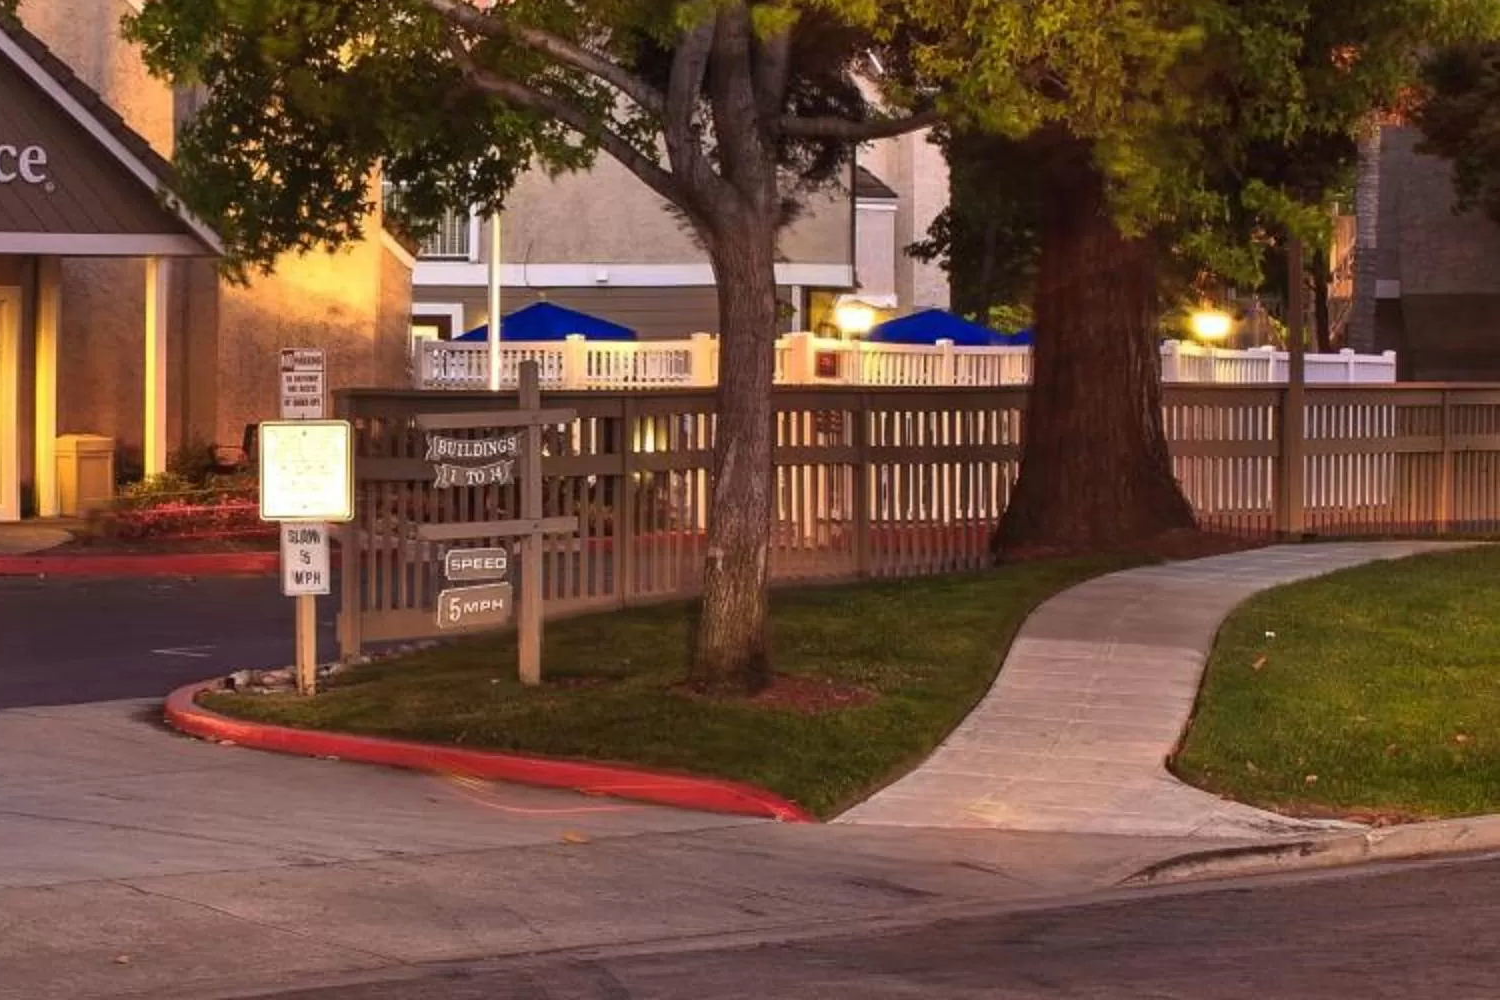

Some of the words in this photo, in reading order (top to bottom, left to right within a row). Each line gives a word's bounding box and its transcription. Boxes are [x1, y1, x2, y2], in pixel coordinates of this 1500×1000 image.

[438, 437, 517, 457] BUILDINGS
[466, 470, 485, 485] TO
[299, 549, 311, 565] 5
[451, 557, 507, 571] SPEED
[294, 570, 321, 585] MPH
[449, 597, 461, 622] 5
[463, 599, 504, 613] MPH
